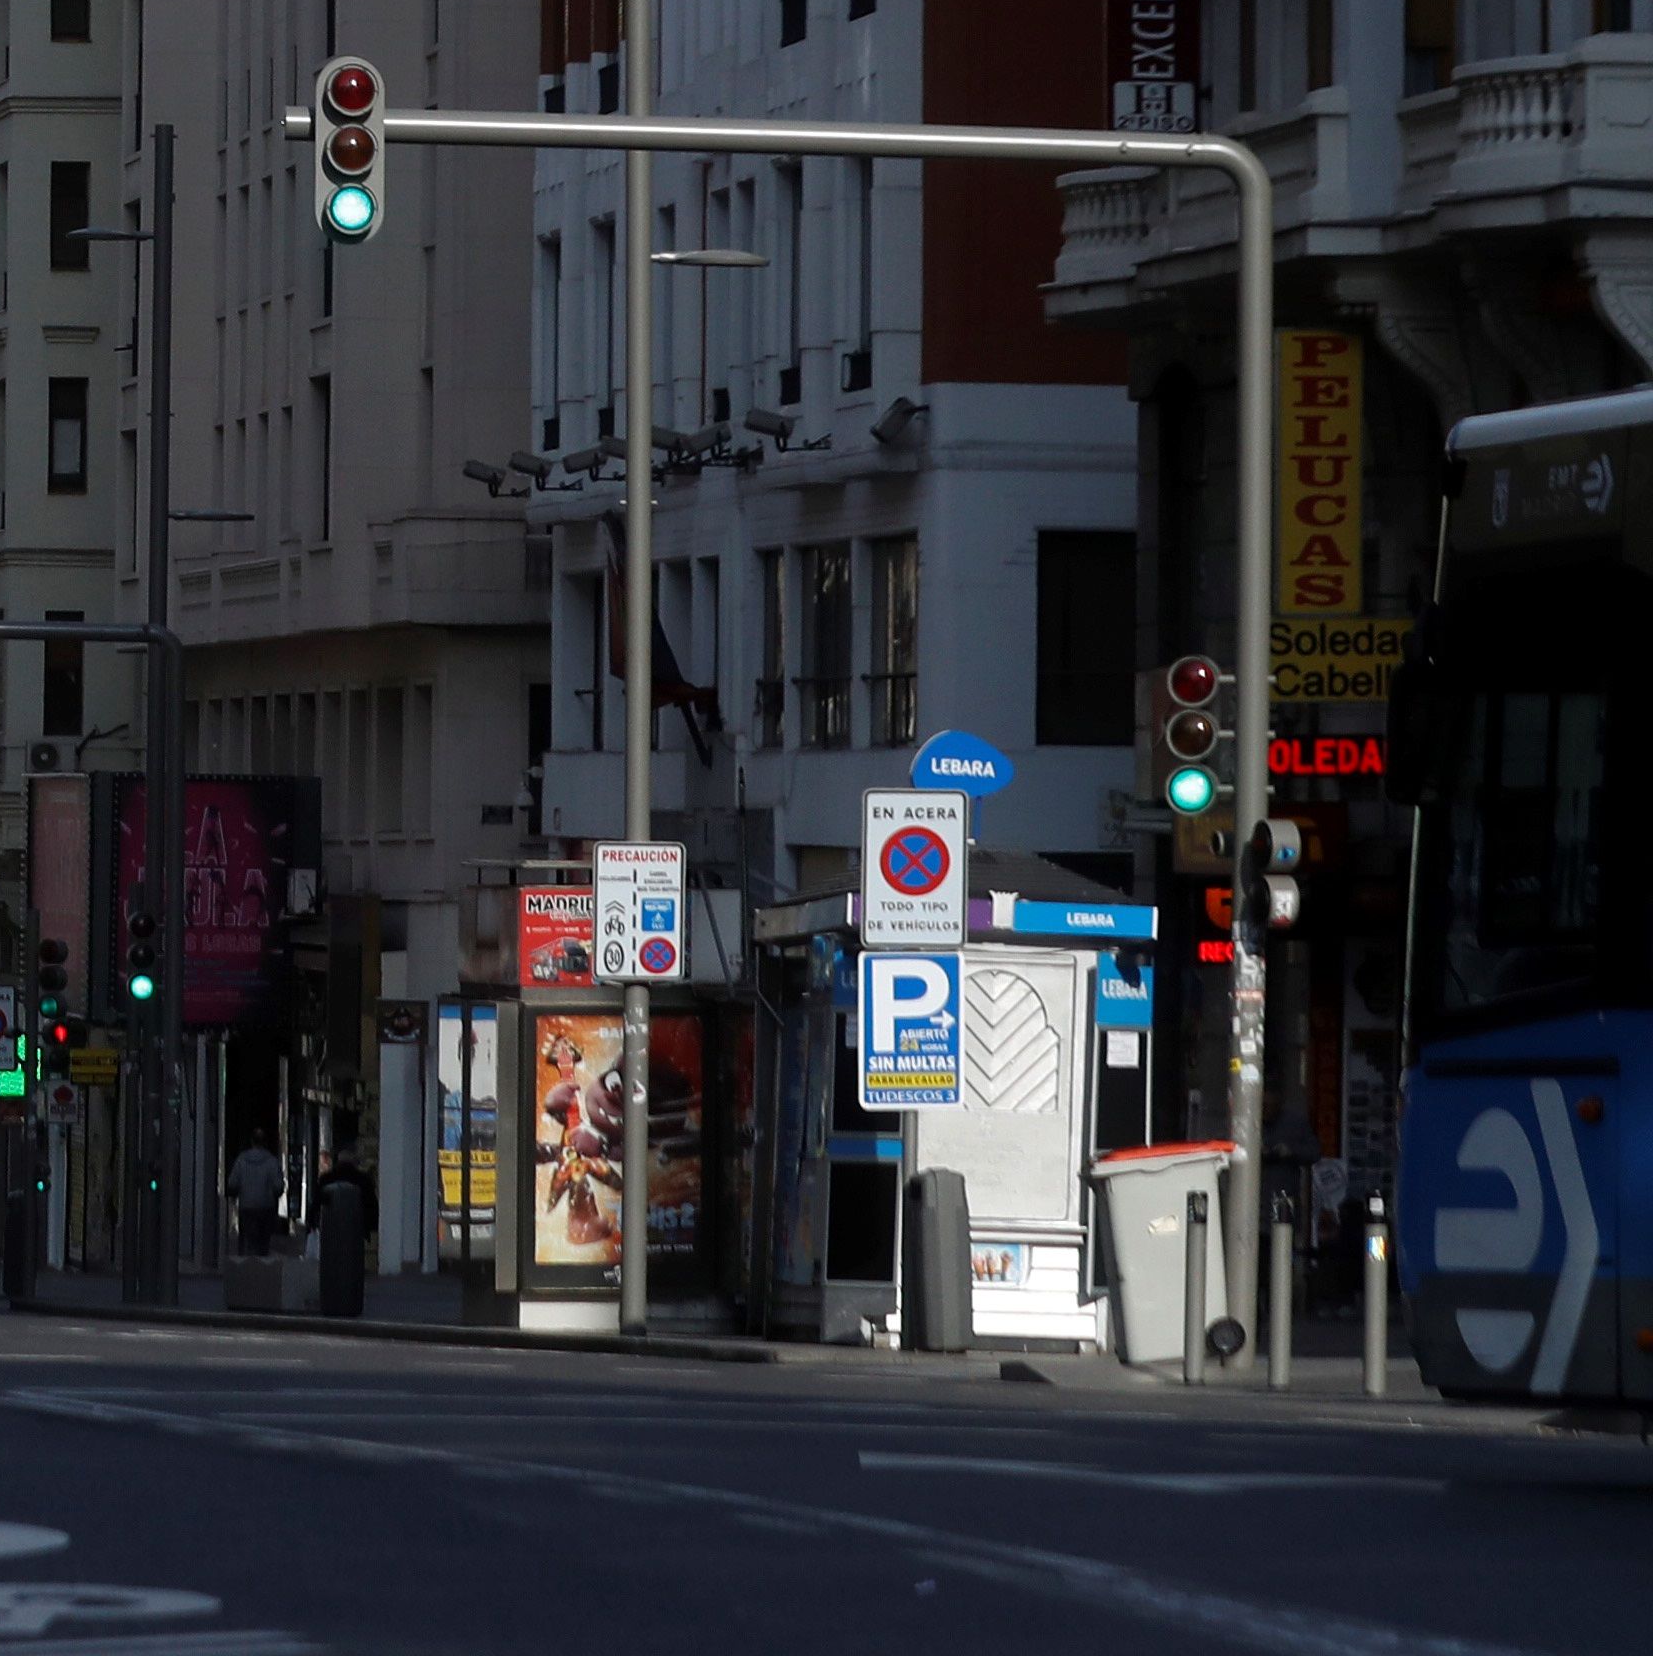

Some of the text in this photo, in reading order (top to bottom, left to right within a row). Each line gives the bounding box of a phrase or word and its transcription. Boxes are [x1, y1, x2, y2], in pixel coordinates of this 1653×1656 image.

[1289, 335, 1352, 607] PELUCAS
[931, 757, 996, 779] LEBARA
[872, 807, 957, 820] EN ACERA
[602, 848, 678, 862] PRECAUCIÓN
[881, 900, 949, 912] TODO TIPO
[868, 919, 960, 931] DE VEHÍCULOS
[1066, 911, 1116, 929] LEBARA
[607, 947, 621, 966] 30
[873, 959, 950, 1053] P
[899, 1028, 950, 1041] ABIERTO
[900, 1038, 919, 1052] 24
[868, 1055, 956, 1072] SIN MULTAS
[868, 1075, 954, 1084] PARKING CALLAO
[866, 1090, 955, 1103] TUDESCOS 3
